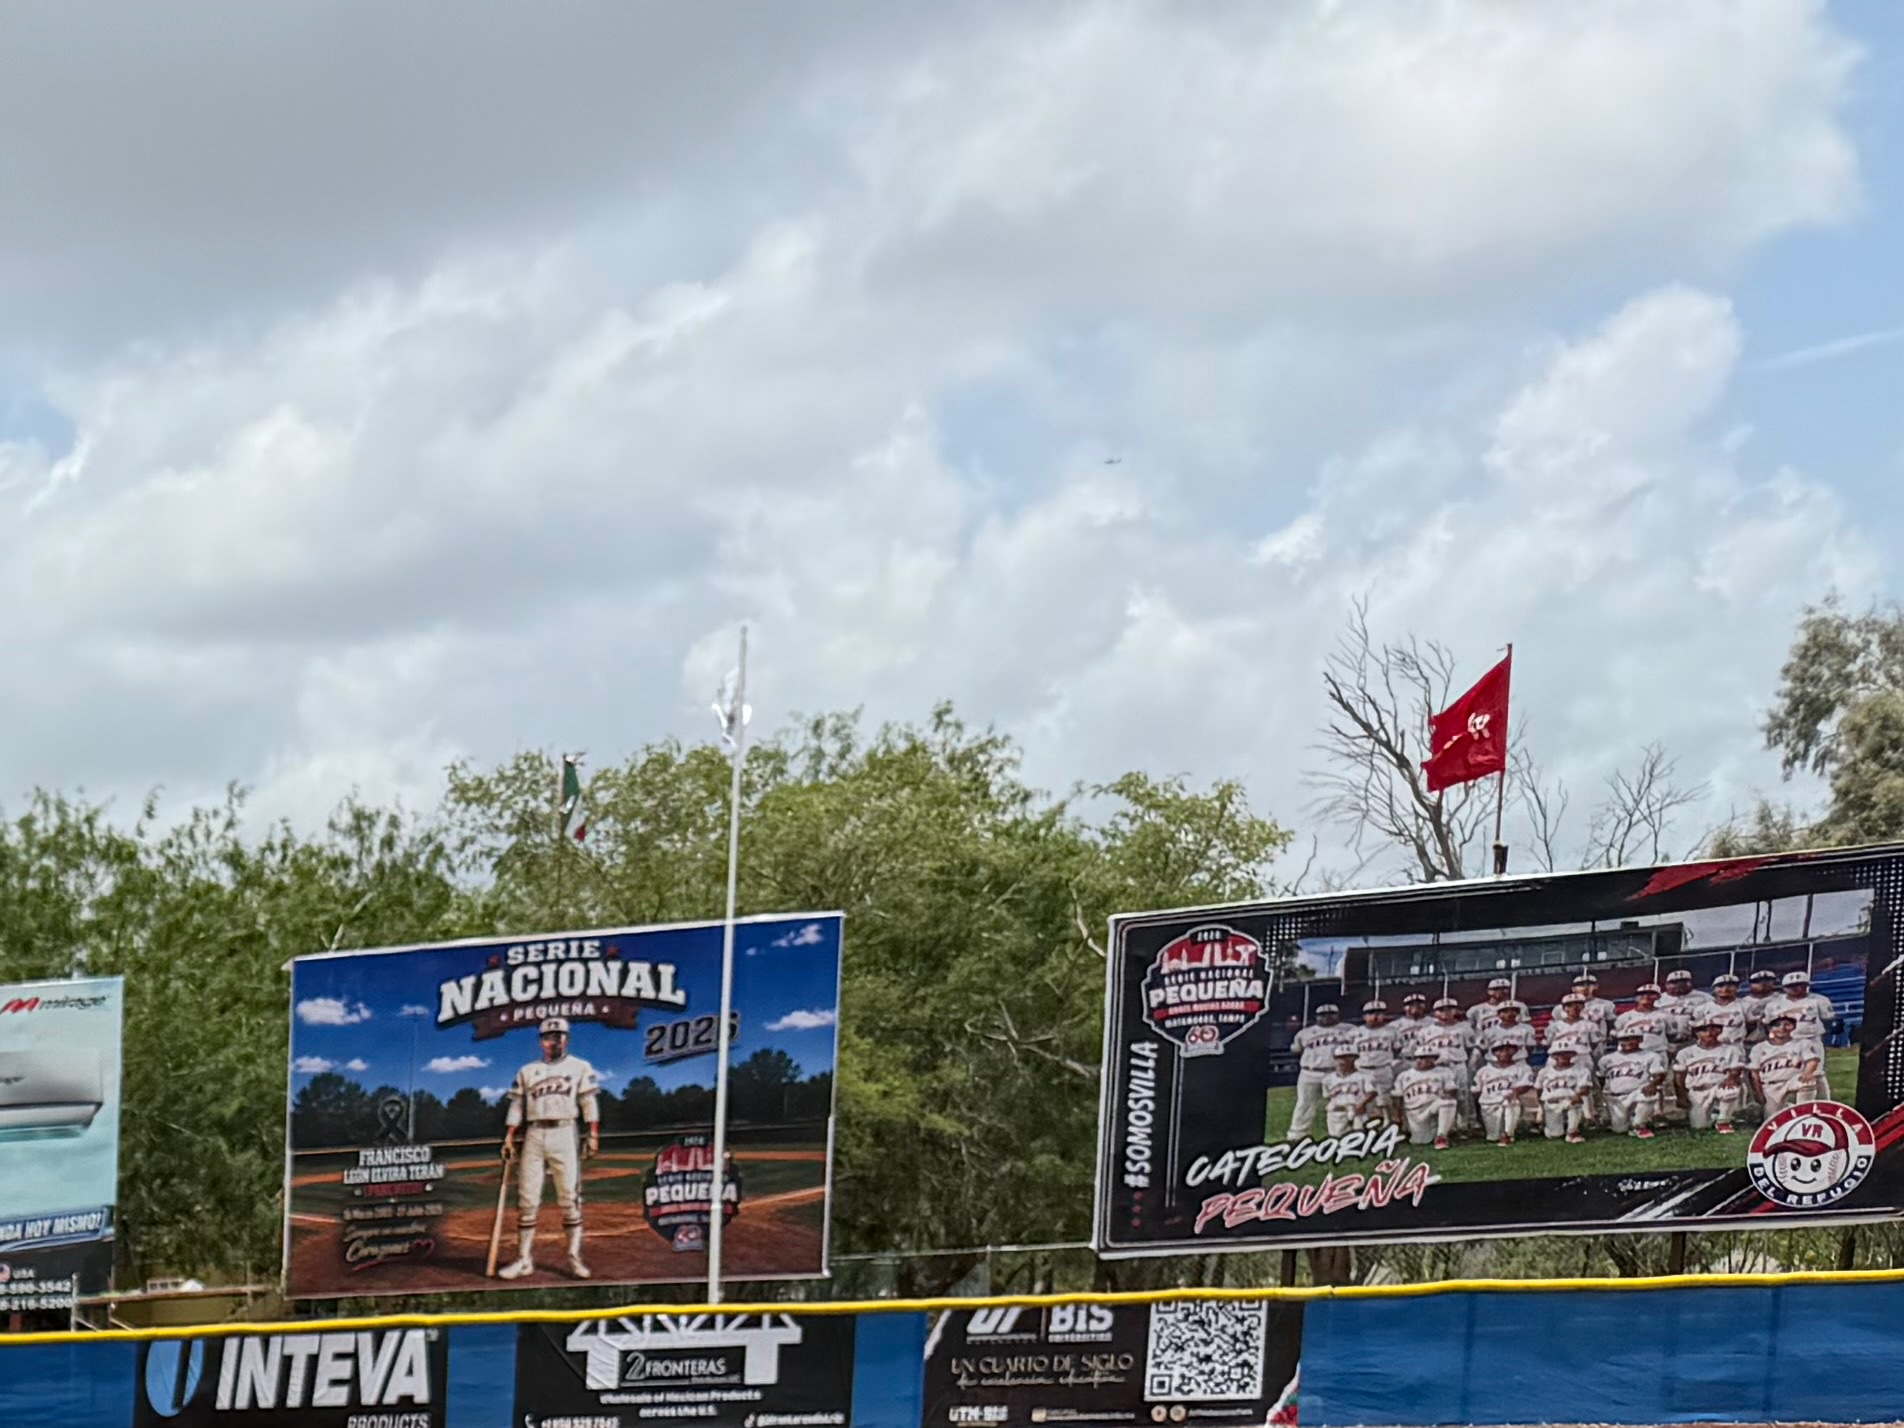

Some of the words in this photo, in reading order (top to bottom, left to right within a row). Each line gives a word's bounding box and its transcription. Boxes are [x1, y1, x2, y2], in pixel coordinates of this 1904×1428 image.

[507, 940, 600, 966] SERIE
[1200, 969, 1254, 981] NACIONAL
[437, 960, 687, 1023] NACIONAL
[1149, 979, 1264, 1008] PEQUEÑA
[513, 1002, 595, 1022] PEQUEÑA
[1125, 1041, 1158, 1189] #SOMOSVILLA
[1767, 1104, 1865, 1132] VILLA
[1802, 1124, 1824, 1138] VR
[359, 1146, 431, 1166] FRANCISCO
[1185, 1120, 1405, 1188] CATEGORÍA
[1752, 1162, 1776, 1197] DEL
[1786, 1156, 1870, 1204] REFUGIO
[645, 1182, 738, 1206] PEQUEA
[1194, 1157, 1441, 1235] PEQUEÑA
[24, 1218, 52, 1239] HOY
[52, 1212, 103, 1234] MISMO!
[12, 1268, 36, 1279] USA
[215, 1328, 431, 1410] INTEVA
[626, 1352, 645, 1380] 2
[645, 1357, 726, 1377] FRONTERAS
[951, 1357, 976, 1374] UN
[979, 1355, 1049, 1373] CUARTO
[1053, 1355, 1074, 1371] DE
[1081, 1353, 1134, 1371] SIGLO
[654, 1392, 664, 1403] of
